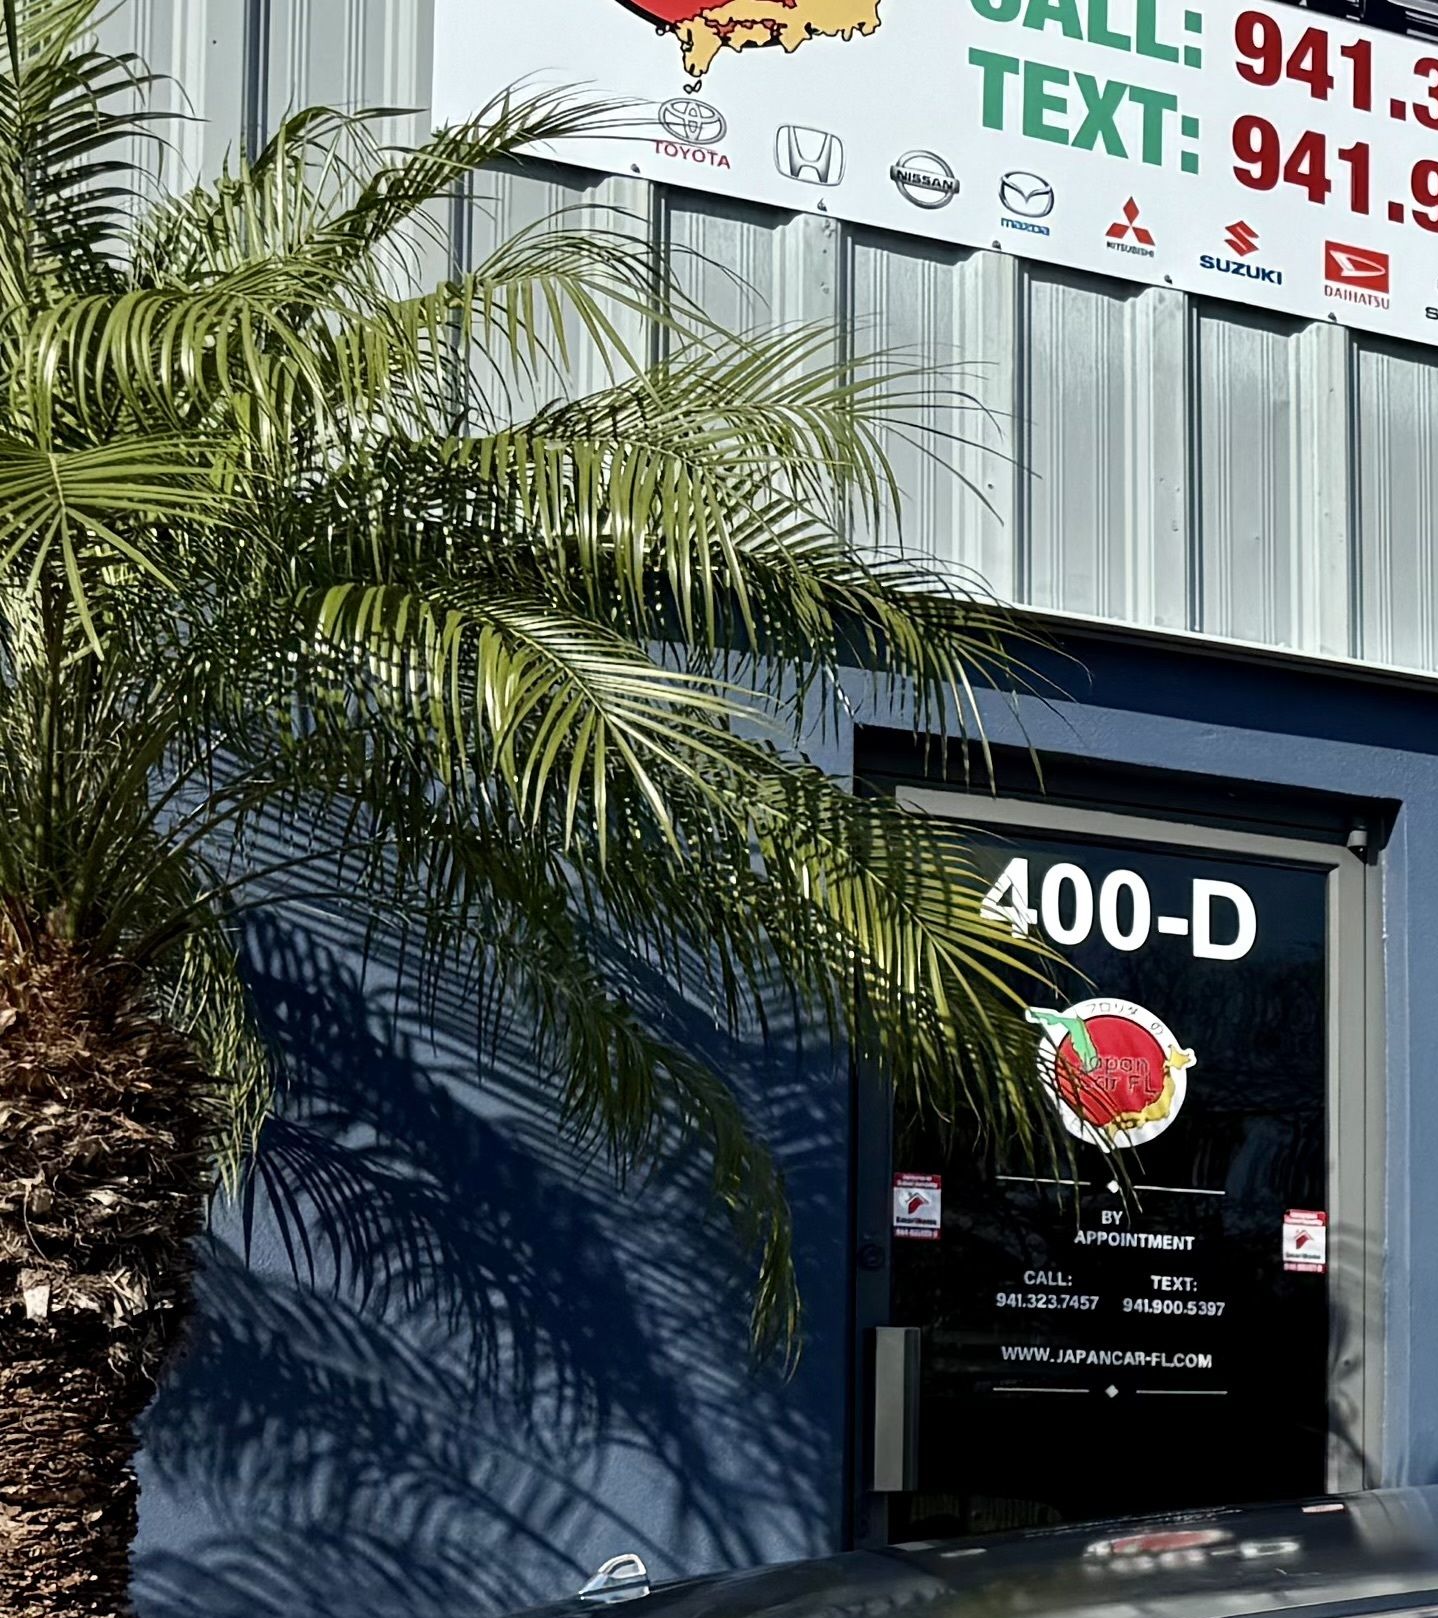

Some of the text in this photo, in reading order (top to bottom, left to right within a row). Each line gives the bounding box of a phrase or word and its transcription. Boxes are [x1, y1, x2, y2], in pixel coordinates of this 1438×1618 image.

[971, 0, 1202, 69] LL:
[968, 46, 1200, 176] TEXT:
[653, 139, 731, 170] TOYOTA
[896, 168, 954, 190] NISSAN
[1106, 240, 1155, 258] MITSUBISHI
[1199, 254, 1283, 286] SUZUKI
[1324, 284, 1391, 311] DAIHATSU
[979, 856, 1257, 961] 400-D
[1086, 1054, 1150, 1075] apan
[1101, 1210, 1124, 1225] BY
[1073, 1229, 1196, 1251] APPOINTMENT
[1023, 1270, 1073, 1287] CALL:
[1150, 1275, 1198, 1292] TEXT:
[996, 1292, 1100, 1310] 941.323.7457
[1122, 1298, 1226, 1317] 941.900.5397
[1001, 1346, 1213, 1369] WWW.JAPANCAR-FL.COM
